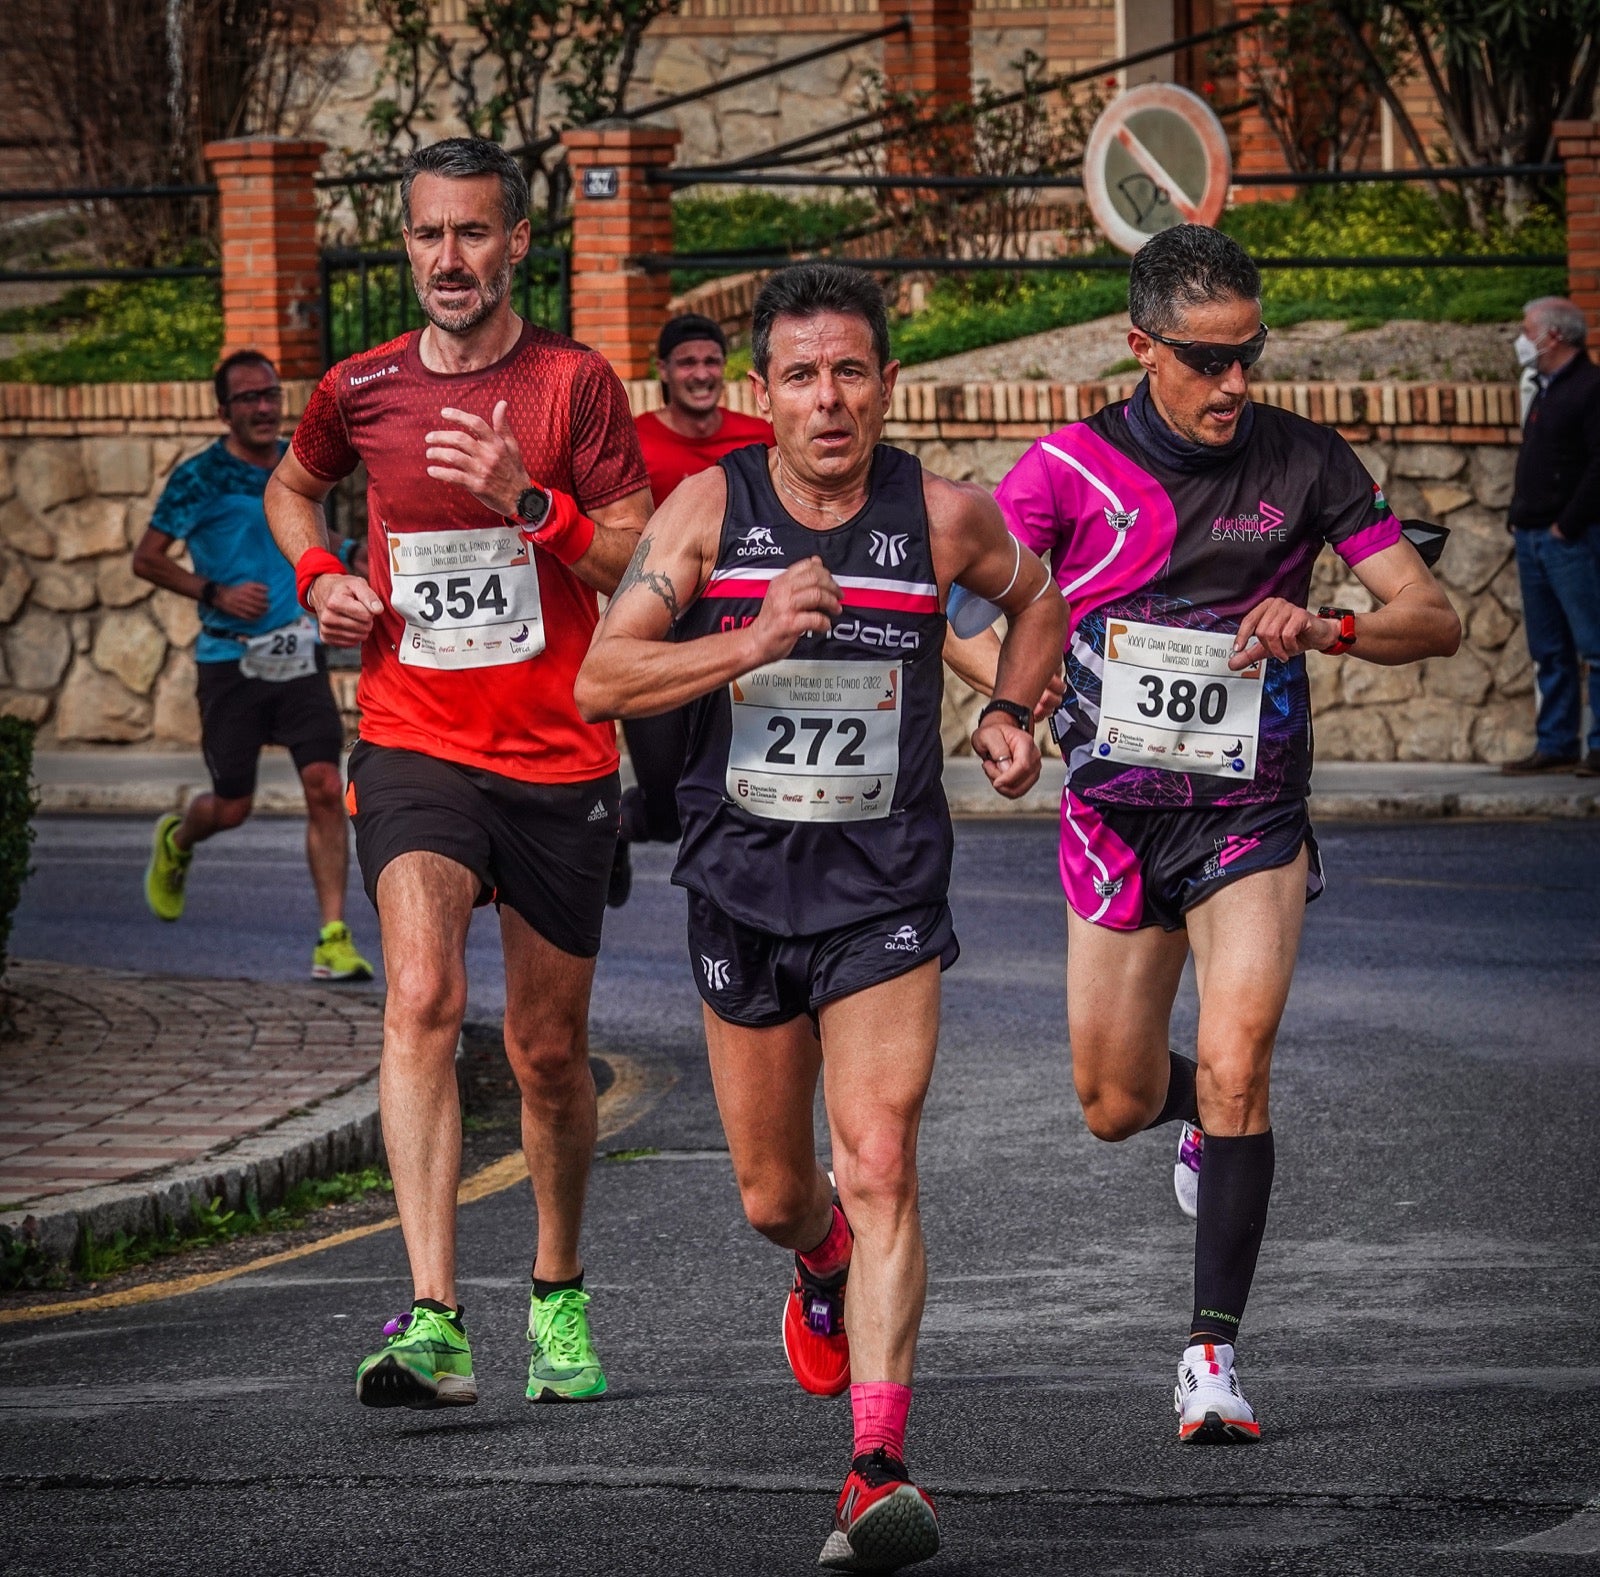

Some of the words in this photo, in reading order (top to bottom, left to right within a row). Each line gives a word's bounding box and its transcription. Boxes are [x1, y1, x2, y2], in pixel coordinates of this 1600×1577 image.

[1238, 513, 1259, 521] CLUB
[1211, 528, 1264, 542] SANTA
[1269, 529, 1287, 542] FE
[736, 546, 785, 556] austral
[414, 574, 507, 623] 354
[271, 634, 297, 655] 28
[1148, 637, 1165, 650] GRAN
[1168, 640, 1192, 655] PREMIO
[1205, 645, 1226, 658] FONDO
[772, 674, 792, 687] GRAN
[836, 676, 860, 689] FONDO
[863, 676, 881, 689] 2022
[1137, 674, 1228, 725] 380
[765, 716, 867, 766] 272
